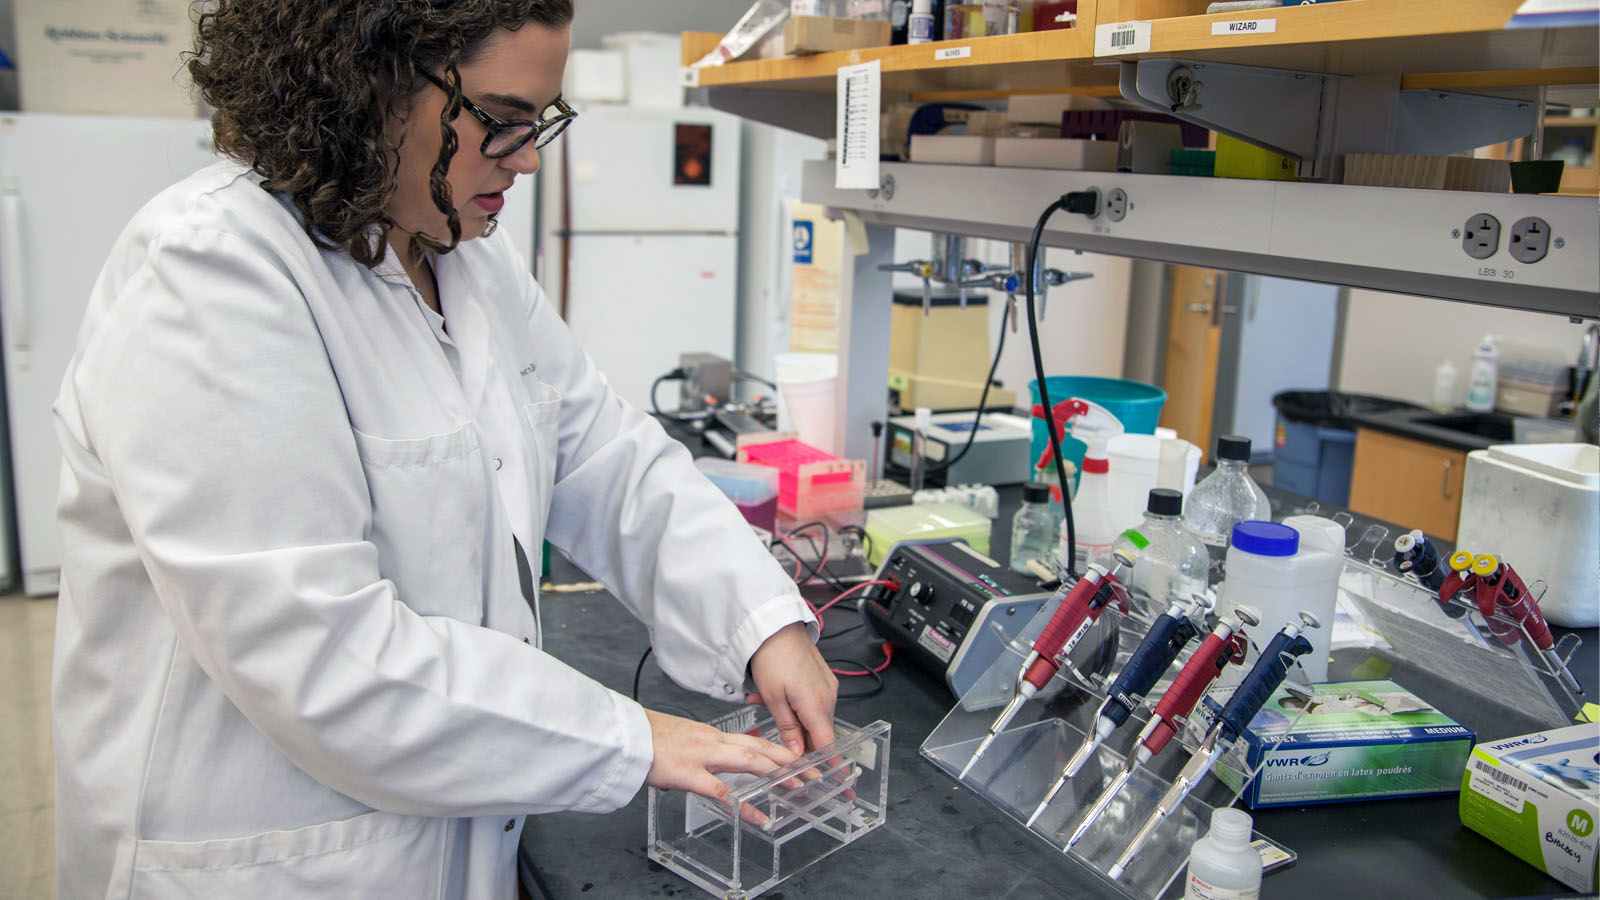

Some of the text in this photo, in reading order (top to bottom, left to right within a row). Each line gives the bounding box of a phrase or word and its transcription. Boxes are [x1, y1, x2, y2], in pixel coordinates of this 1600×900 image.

[1229, 22, 1257, 31] WIZARD
[1502, 270, 1514, 279] 30
[1425, 727, 1468, 735] MEDIUM
[1491, 741, 1525, 750] VWR
[1266, 758, 1299, 767] VWR
[1265, 772, 1292, 782] Gants
[1293, 770, 1337, 780] d'examen
[1338, 769, 1350, 777] en
[1352, 767, 1374, 777] latex
[1571, 814, 1589, 834] M
